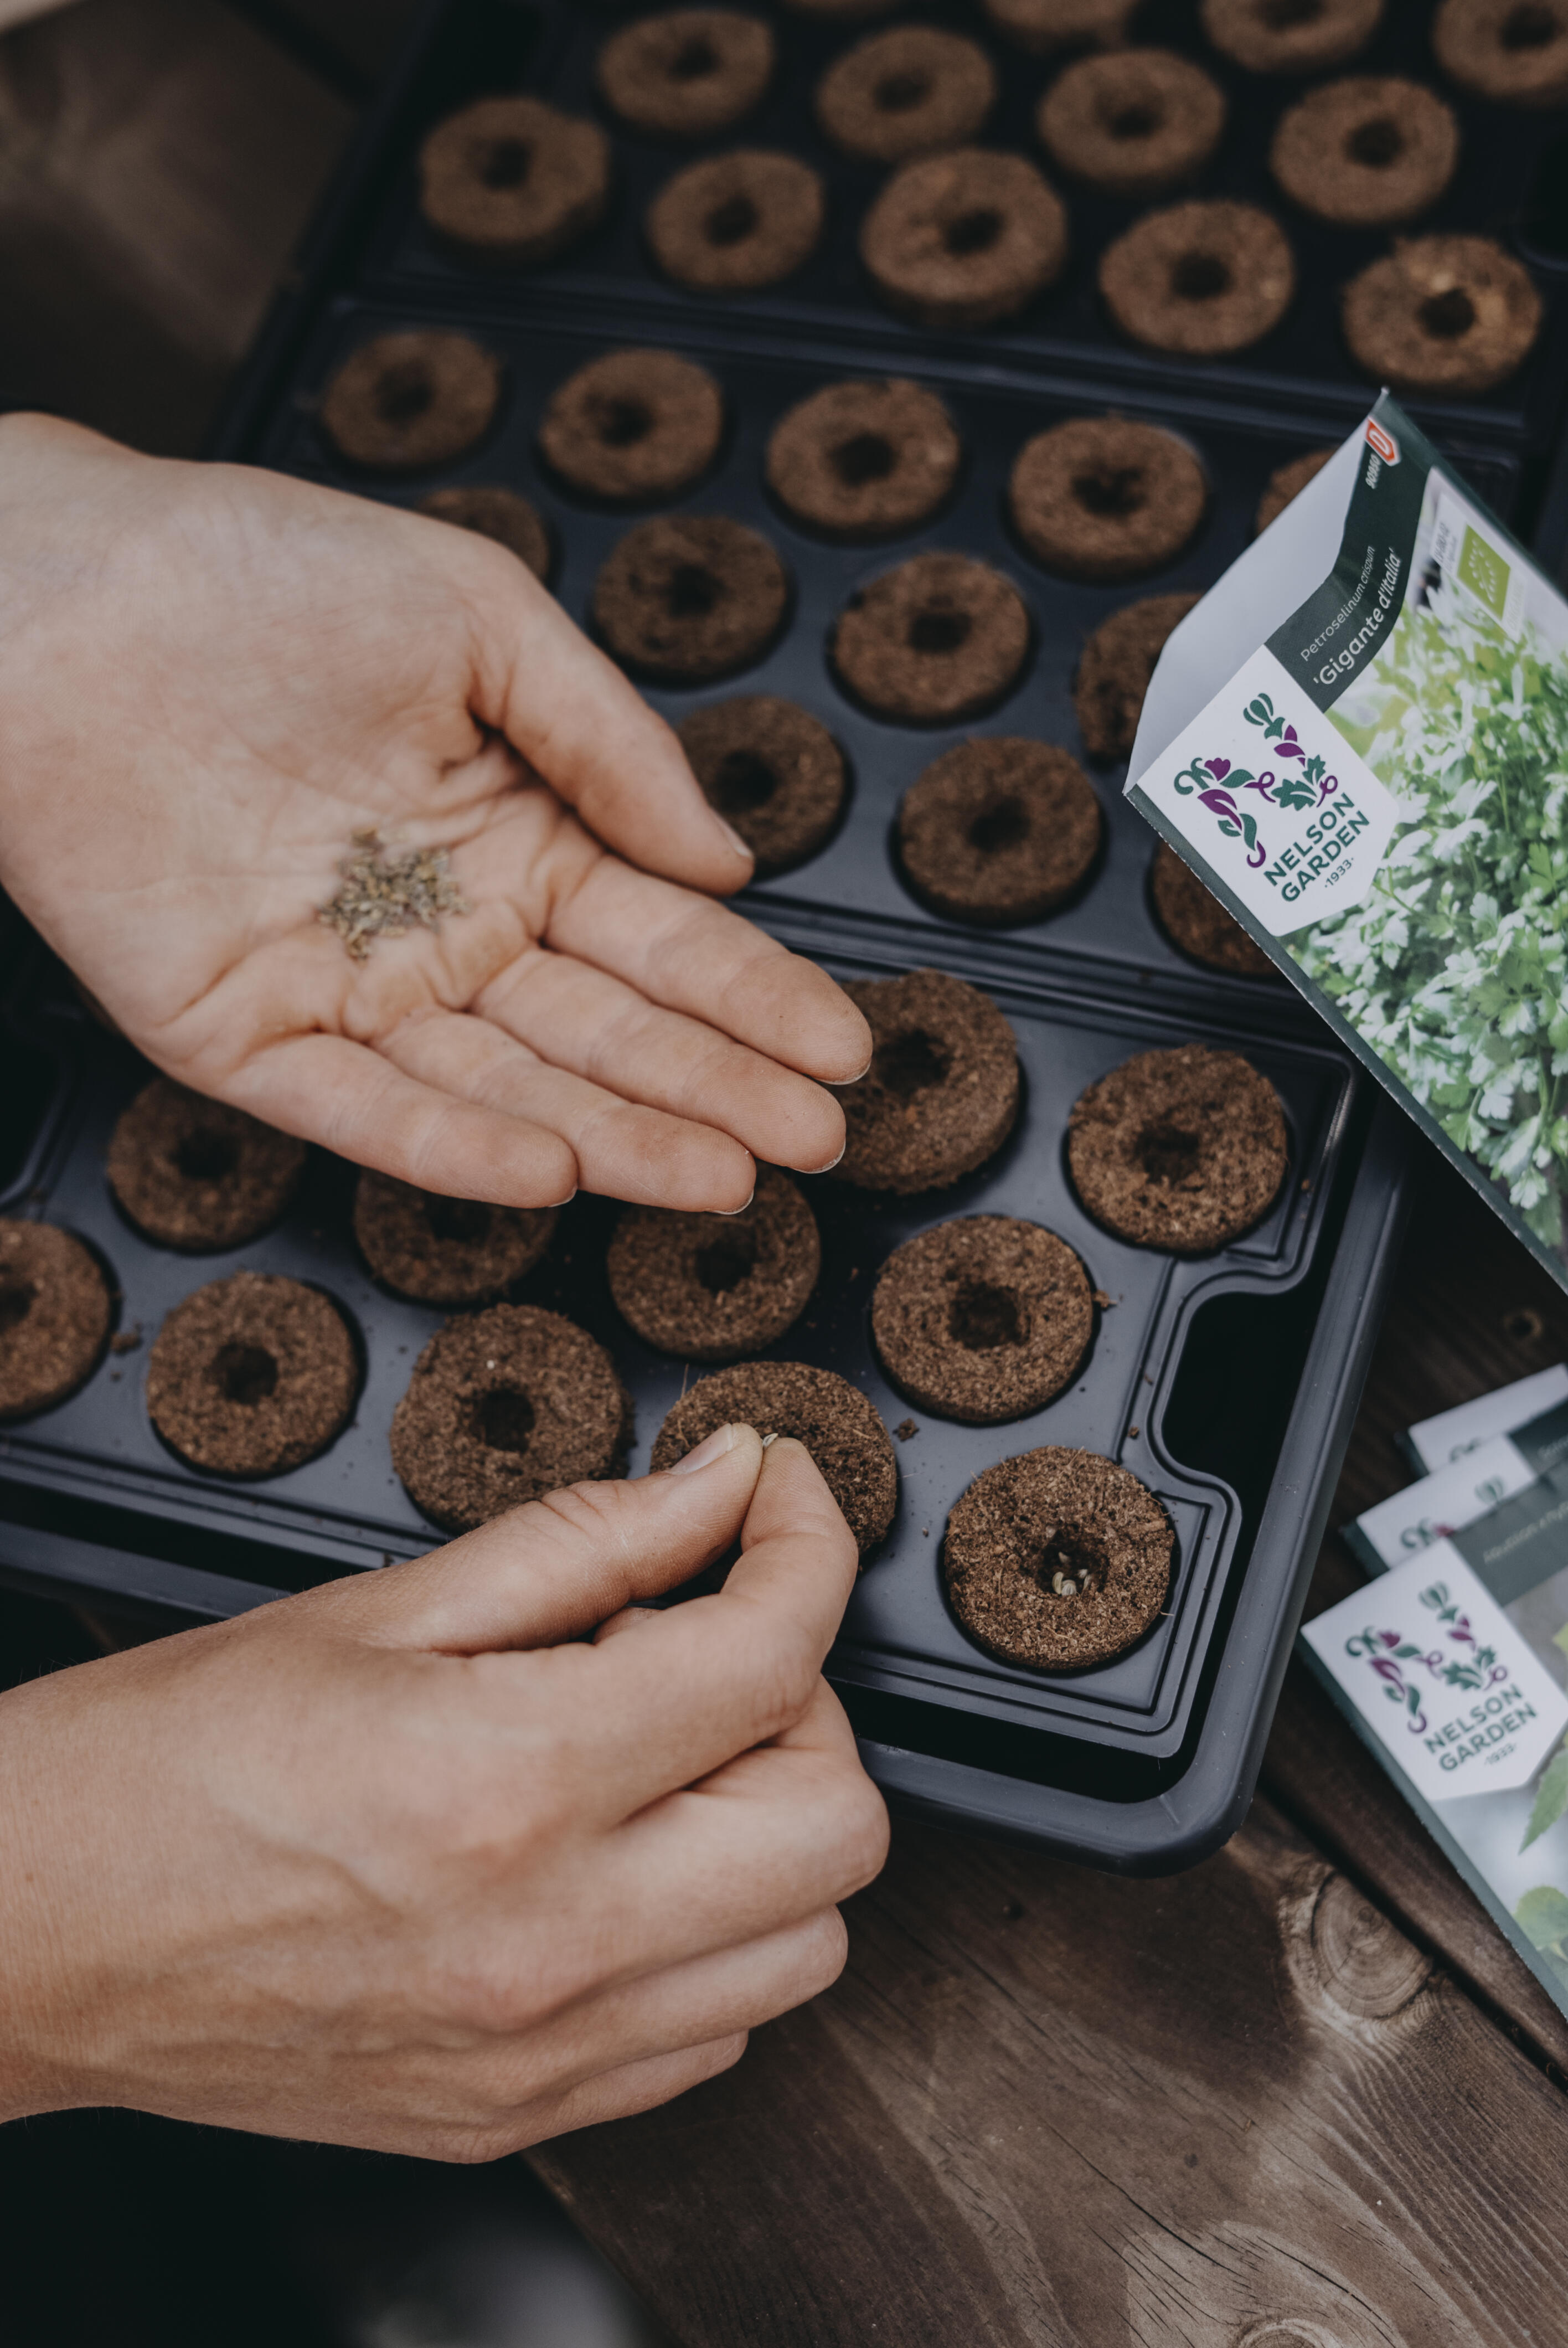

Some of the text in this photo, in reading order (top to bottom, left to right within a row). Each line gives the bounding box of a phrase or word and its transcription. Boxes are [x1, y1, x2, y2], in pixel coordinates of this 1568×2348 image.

[1301, 545, 1375, 662] Petroselinum crispum
[1313, 547, 1401, 684] 'Gigante d'Italia'
[1263, 792, 1355, 887] NELSON
[1281, 810, 1370, 902] GARDEN
[1423, 1682, 1523, 1754] NELSON
[1439, 1702, 1538, 1770] GARDEN
